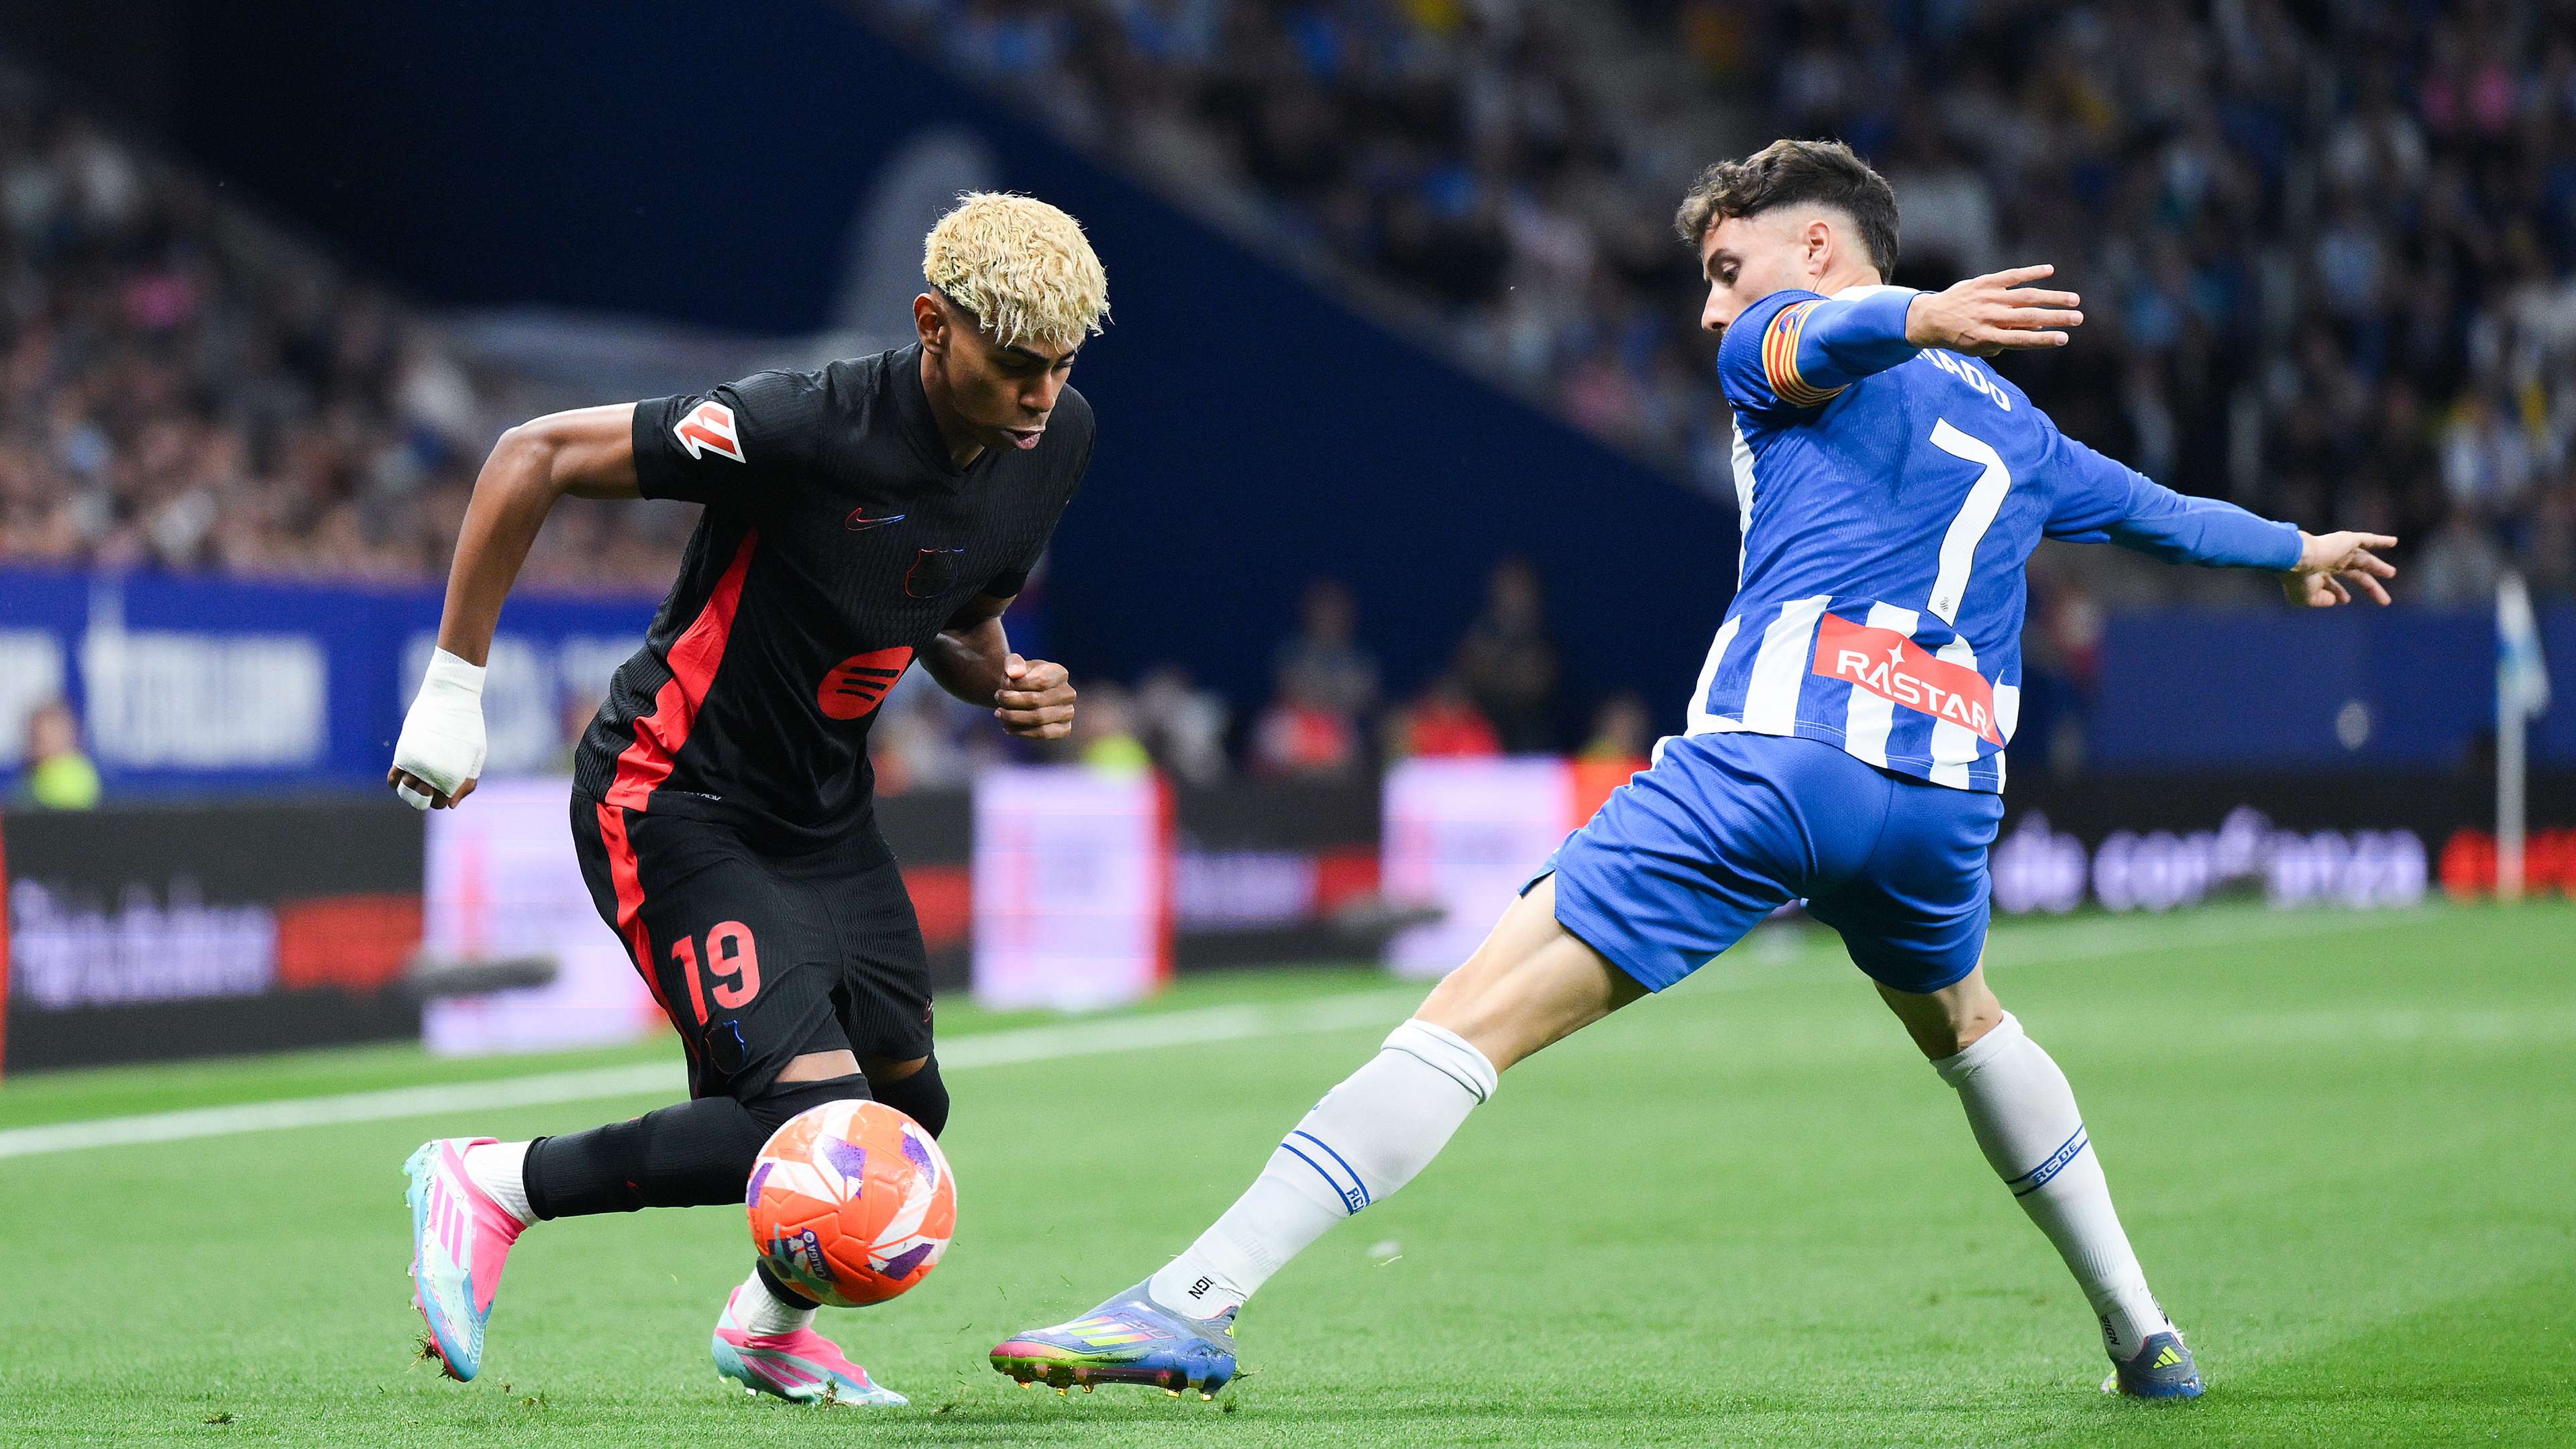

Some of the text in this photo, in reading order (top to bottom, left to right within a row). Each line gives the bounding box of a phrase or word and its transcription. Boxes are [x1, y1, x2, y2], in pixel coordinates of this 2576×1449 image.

[1928, 416, 2012, 628] 7
[1836, 649, 1990, 739] RASTAR
[672, 920, 761, 1026] 19
